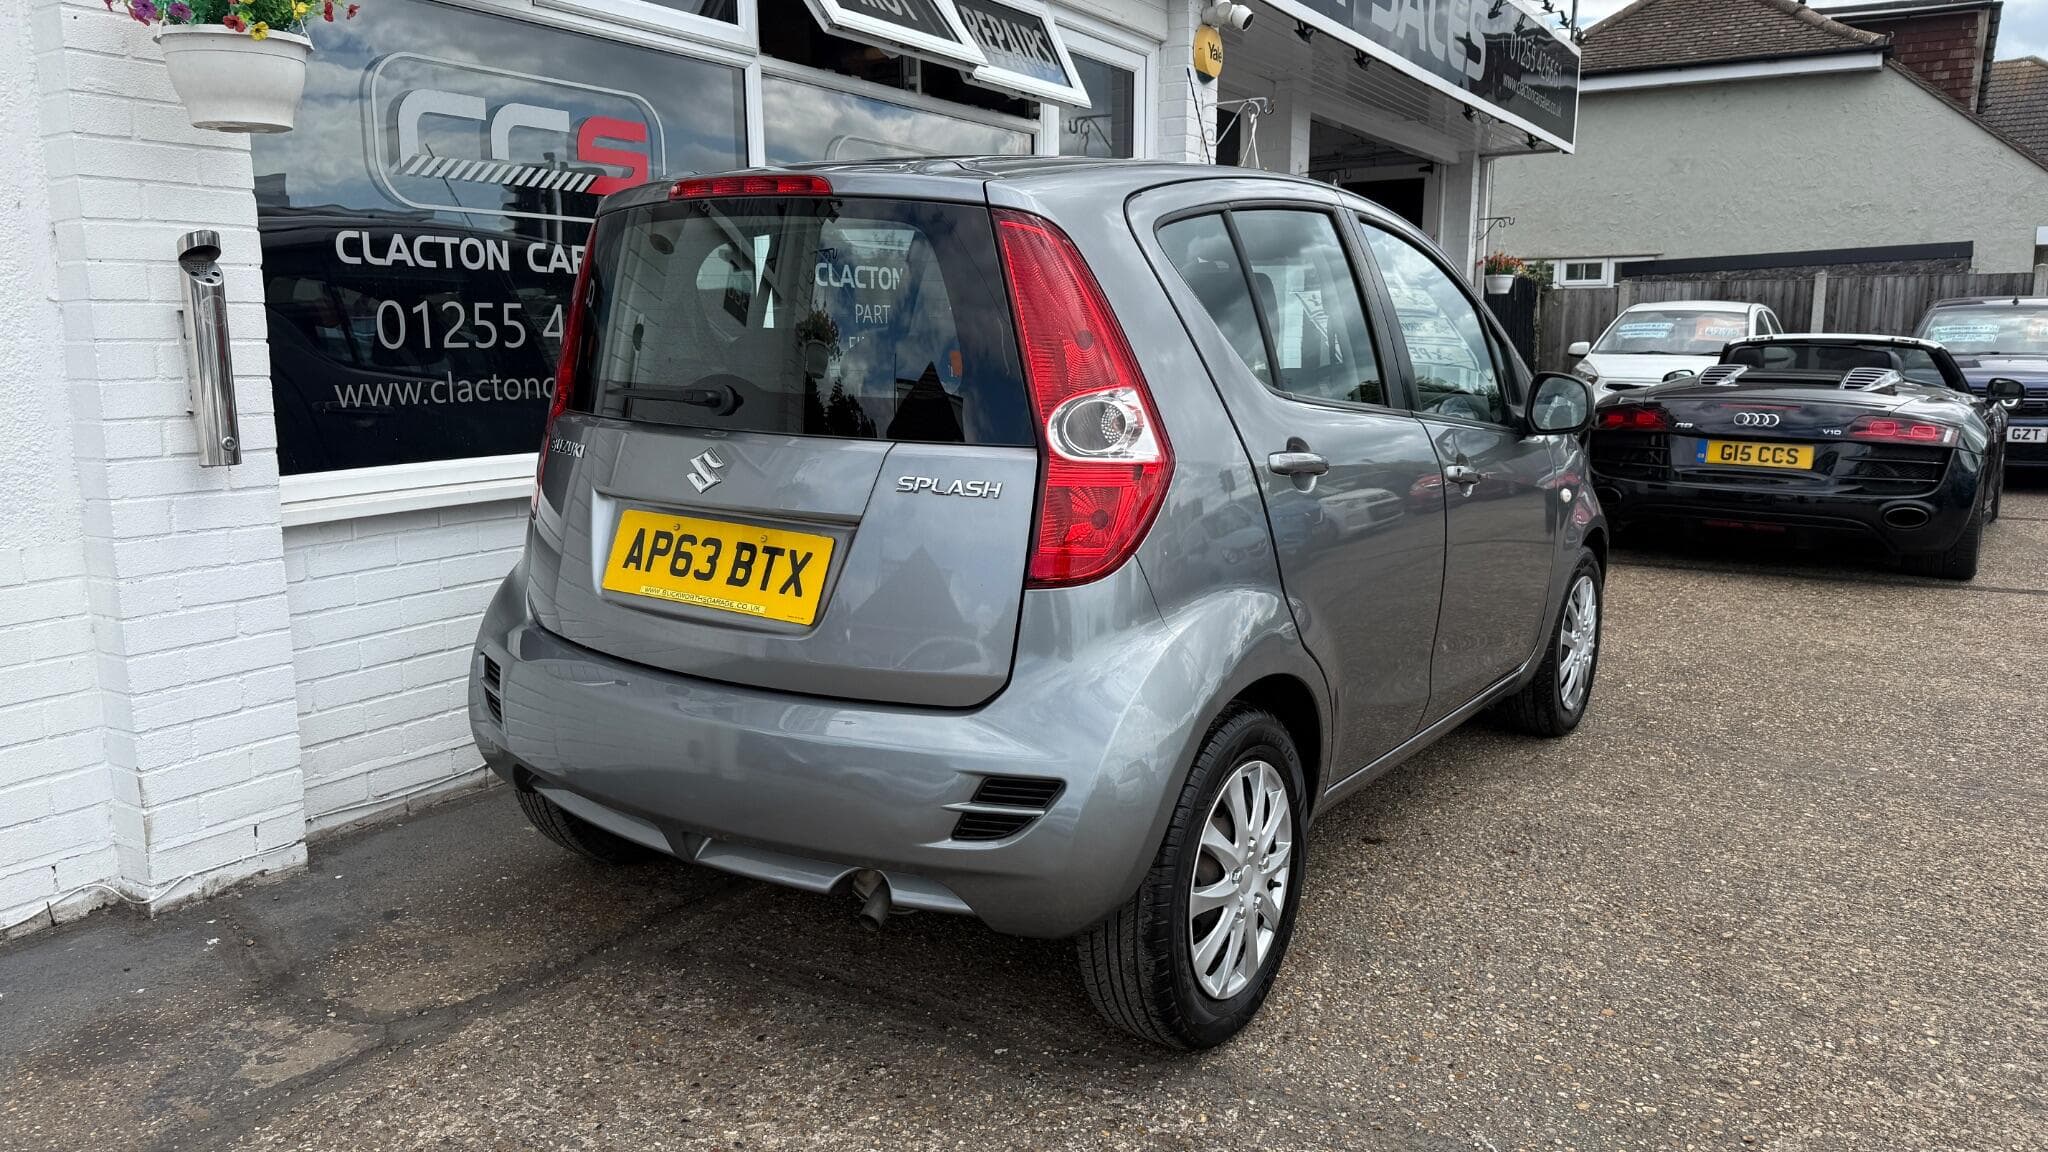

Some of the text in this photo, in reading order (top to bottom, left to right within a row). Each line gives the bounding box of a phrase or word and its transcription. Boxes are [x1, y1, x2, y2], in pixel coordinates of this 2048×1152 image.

[959, 5, 1056, 69] REPAIRS
[335, 230, 510, 271] CLACTON
[815, 262, 903, 290] CLACTON
[376, 300, 526, 350] 01255
[855, 304, 891, 324] PART
[1822, 428, 1842, 436] V10
[2012, 428, 2041, 441] GZT
[551, 437, 586, 459] SUZUKI
[1720, 444, 1800, 465] G15 CCS
[896, 476, 1003, 499] SPLASH
[622, 527, 814, 598] AP63 BTX
